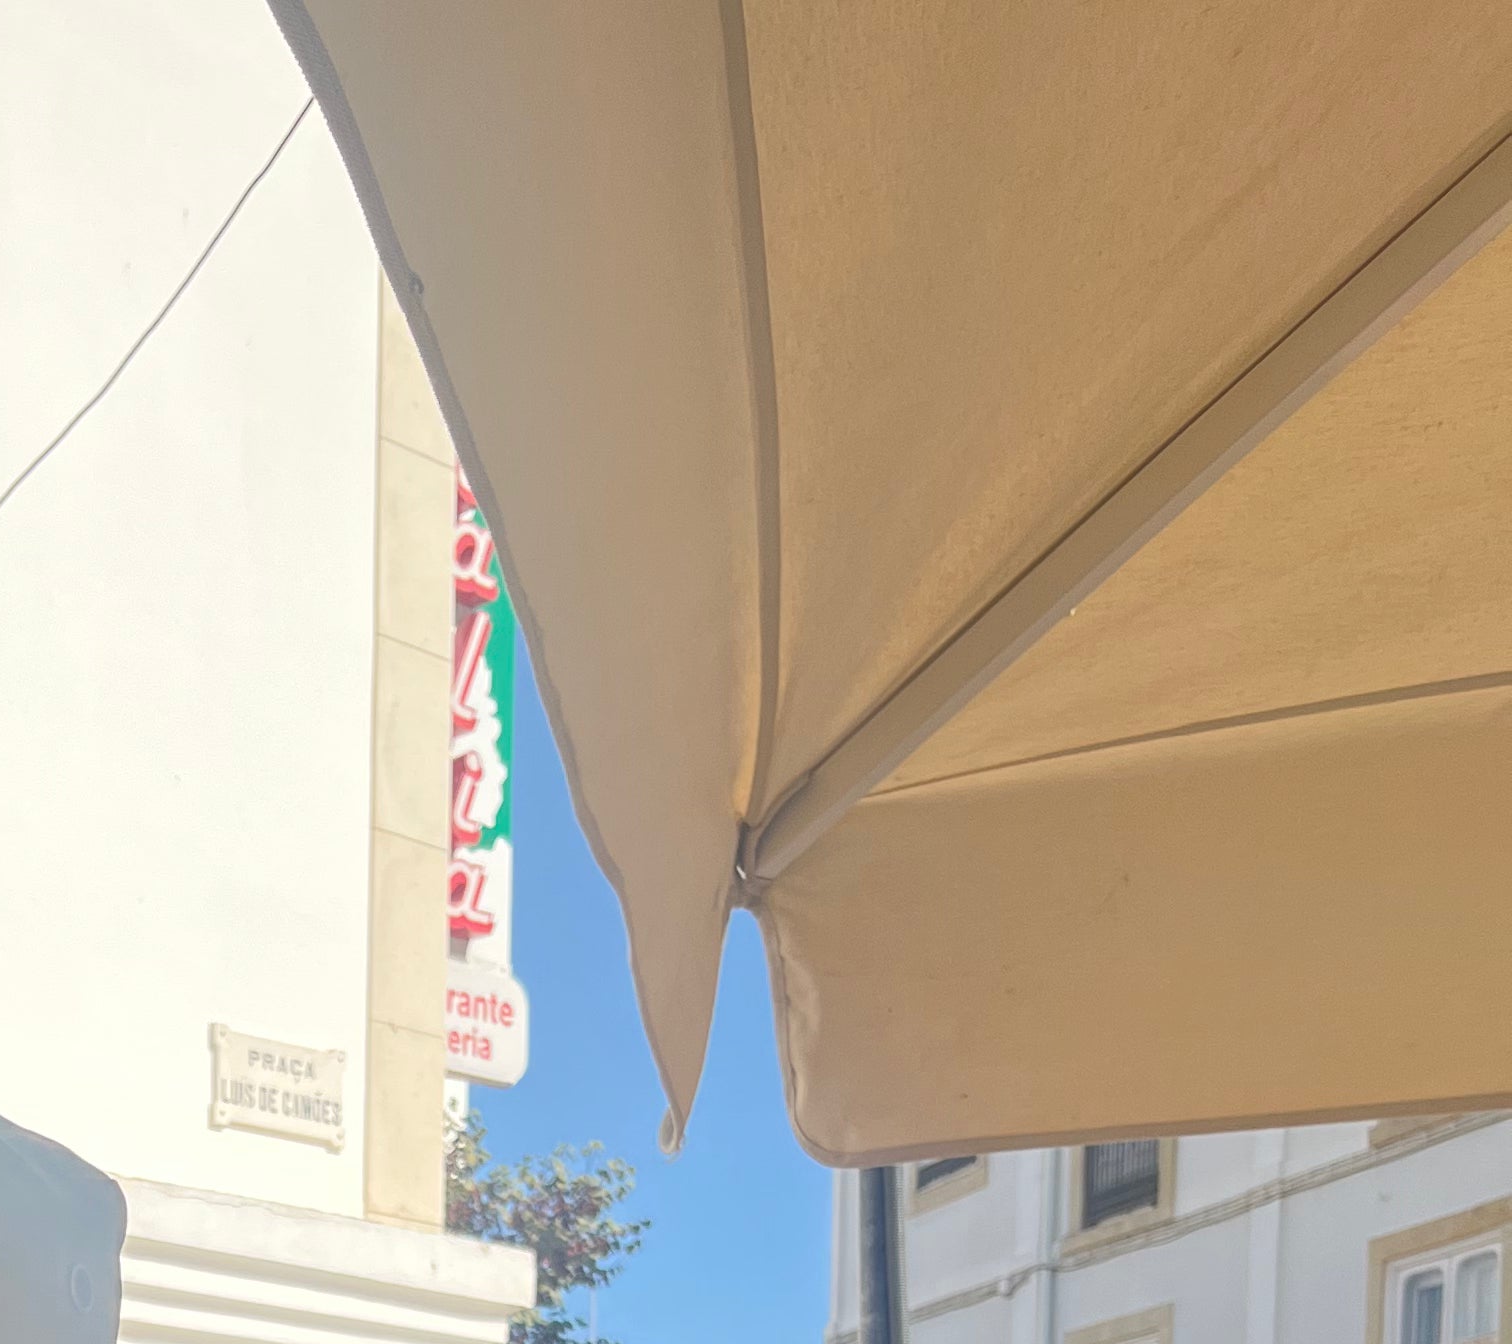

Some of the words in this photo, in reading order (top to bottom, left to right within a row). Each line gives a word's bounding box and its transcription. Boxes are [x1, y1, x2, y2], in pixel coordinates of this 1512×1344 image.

[445, 462, 498, 937] alia
[446, 988, 515, 1028] rante
[447, 1026, 494, 1062] eria
[248, 1049, 316, 1084] PRAÇA
[258, 1086, 279, 1114] DE
